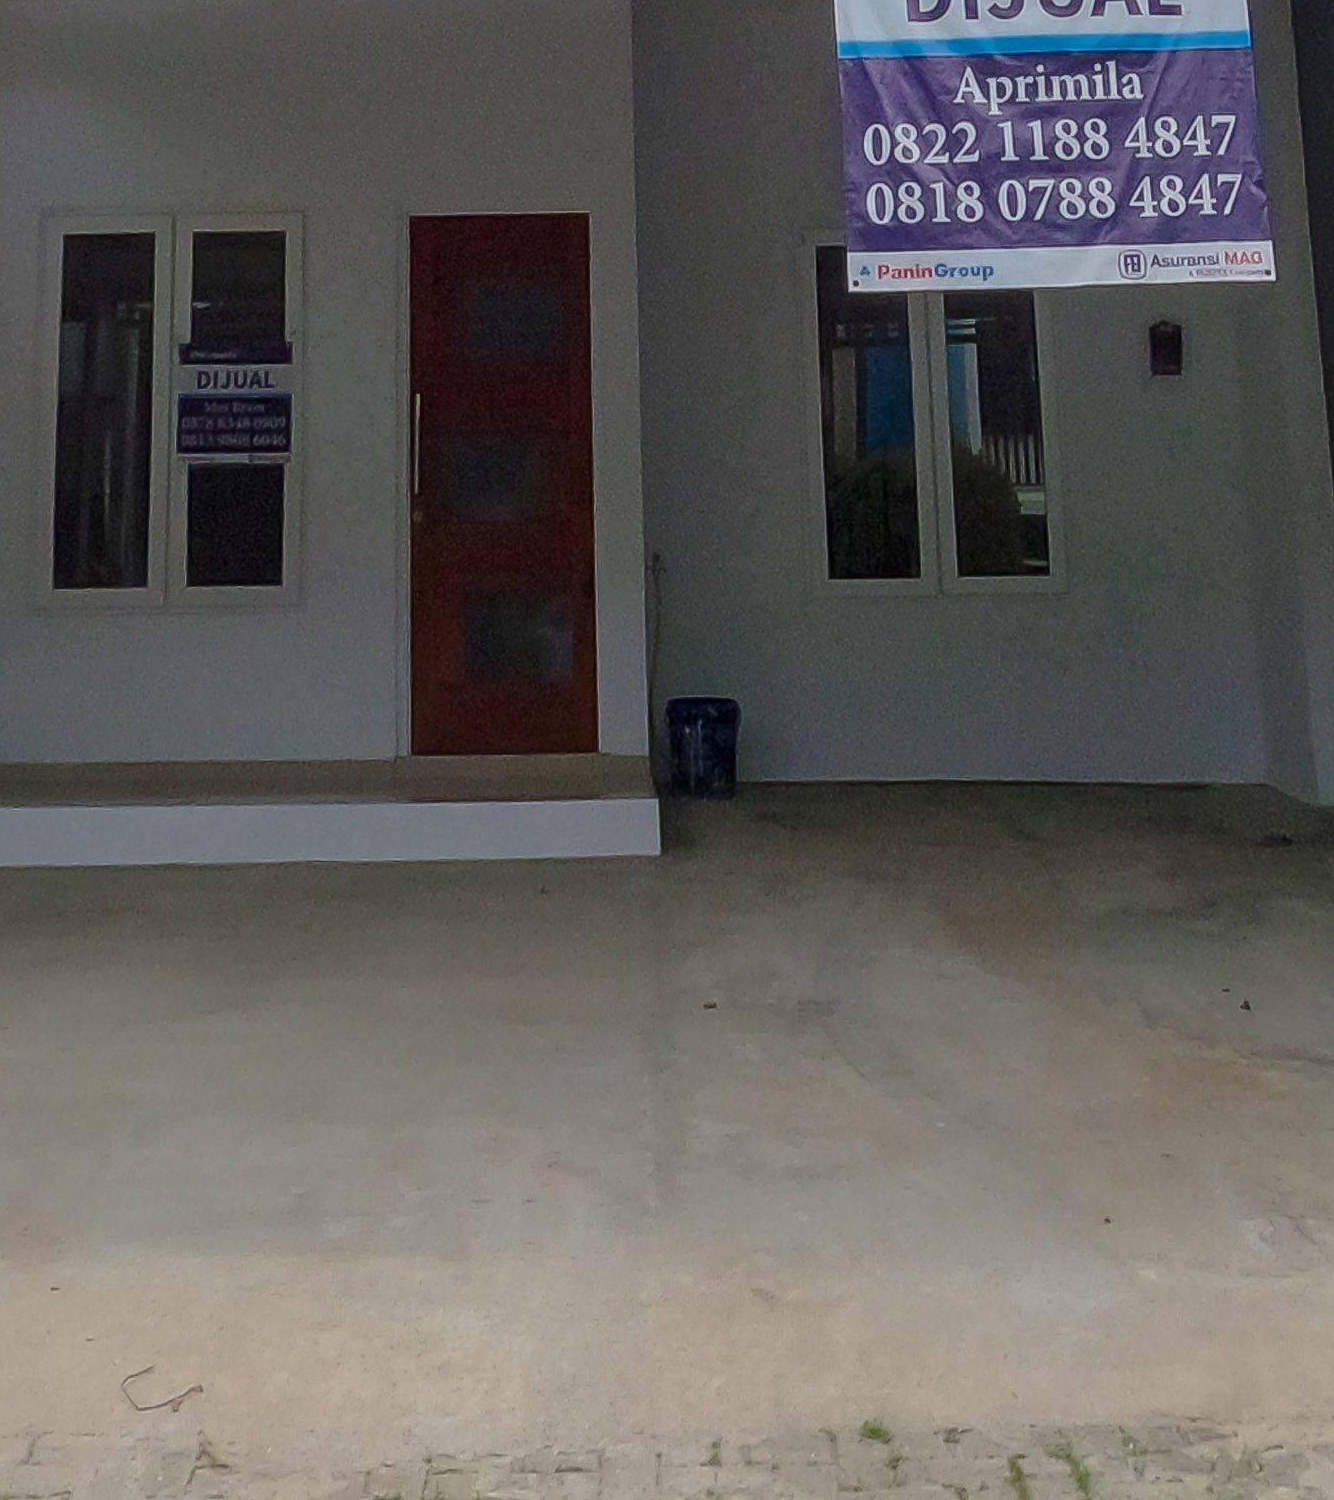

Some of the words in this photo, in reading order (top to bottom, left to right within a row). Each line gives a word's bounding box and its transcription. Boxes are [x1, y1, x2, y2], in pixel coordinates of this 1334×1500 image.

[953, 61, 1144, 115] Aprimila
[863, 122, 980, 166] 0822
[1000, 117, 1110, 161] 1188
[1124, 114, 1237, 159] 4847
[866, 180, 985, 224] 0818
[998, 177, 1116, 222] 0788
[1129, 174, 1242, 218] 4847
[196, 370, 275, 389] DIJUAL
